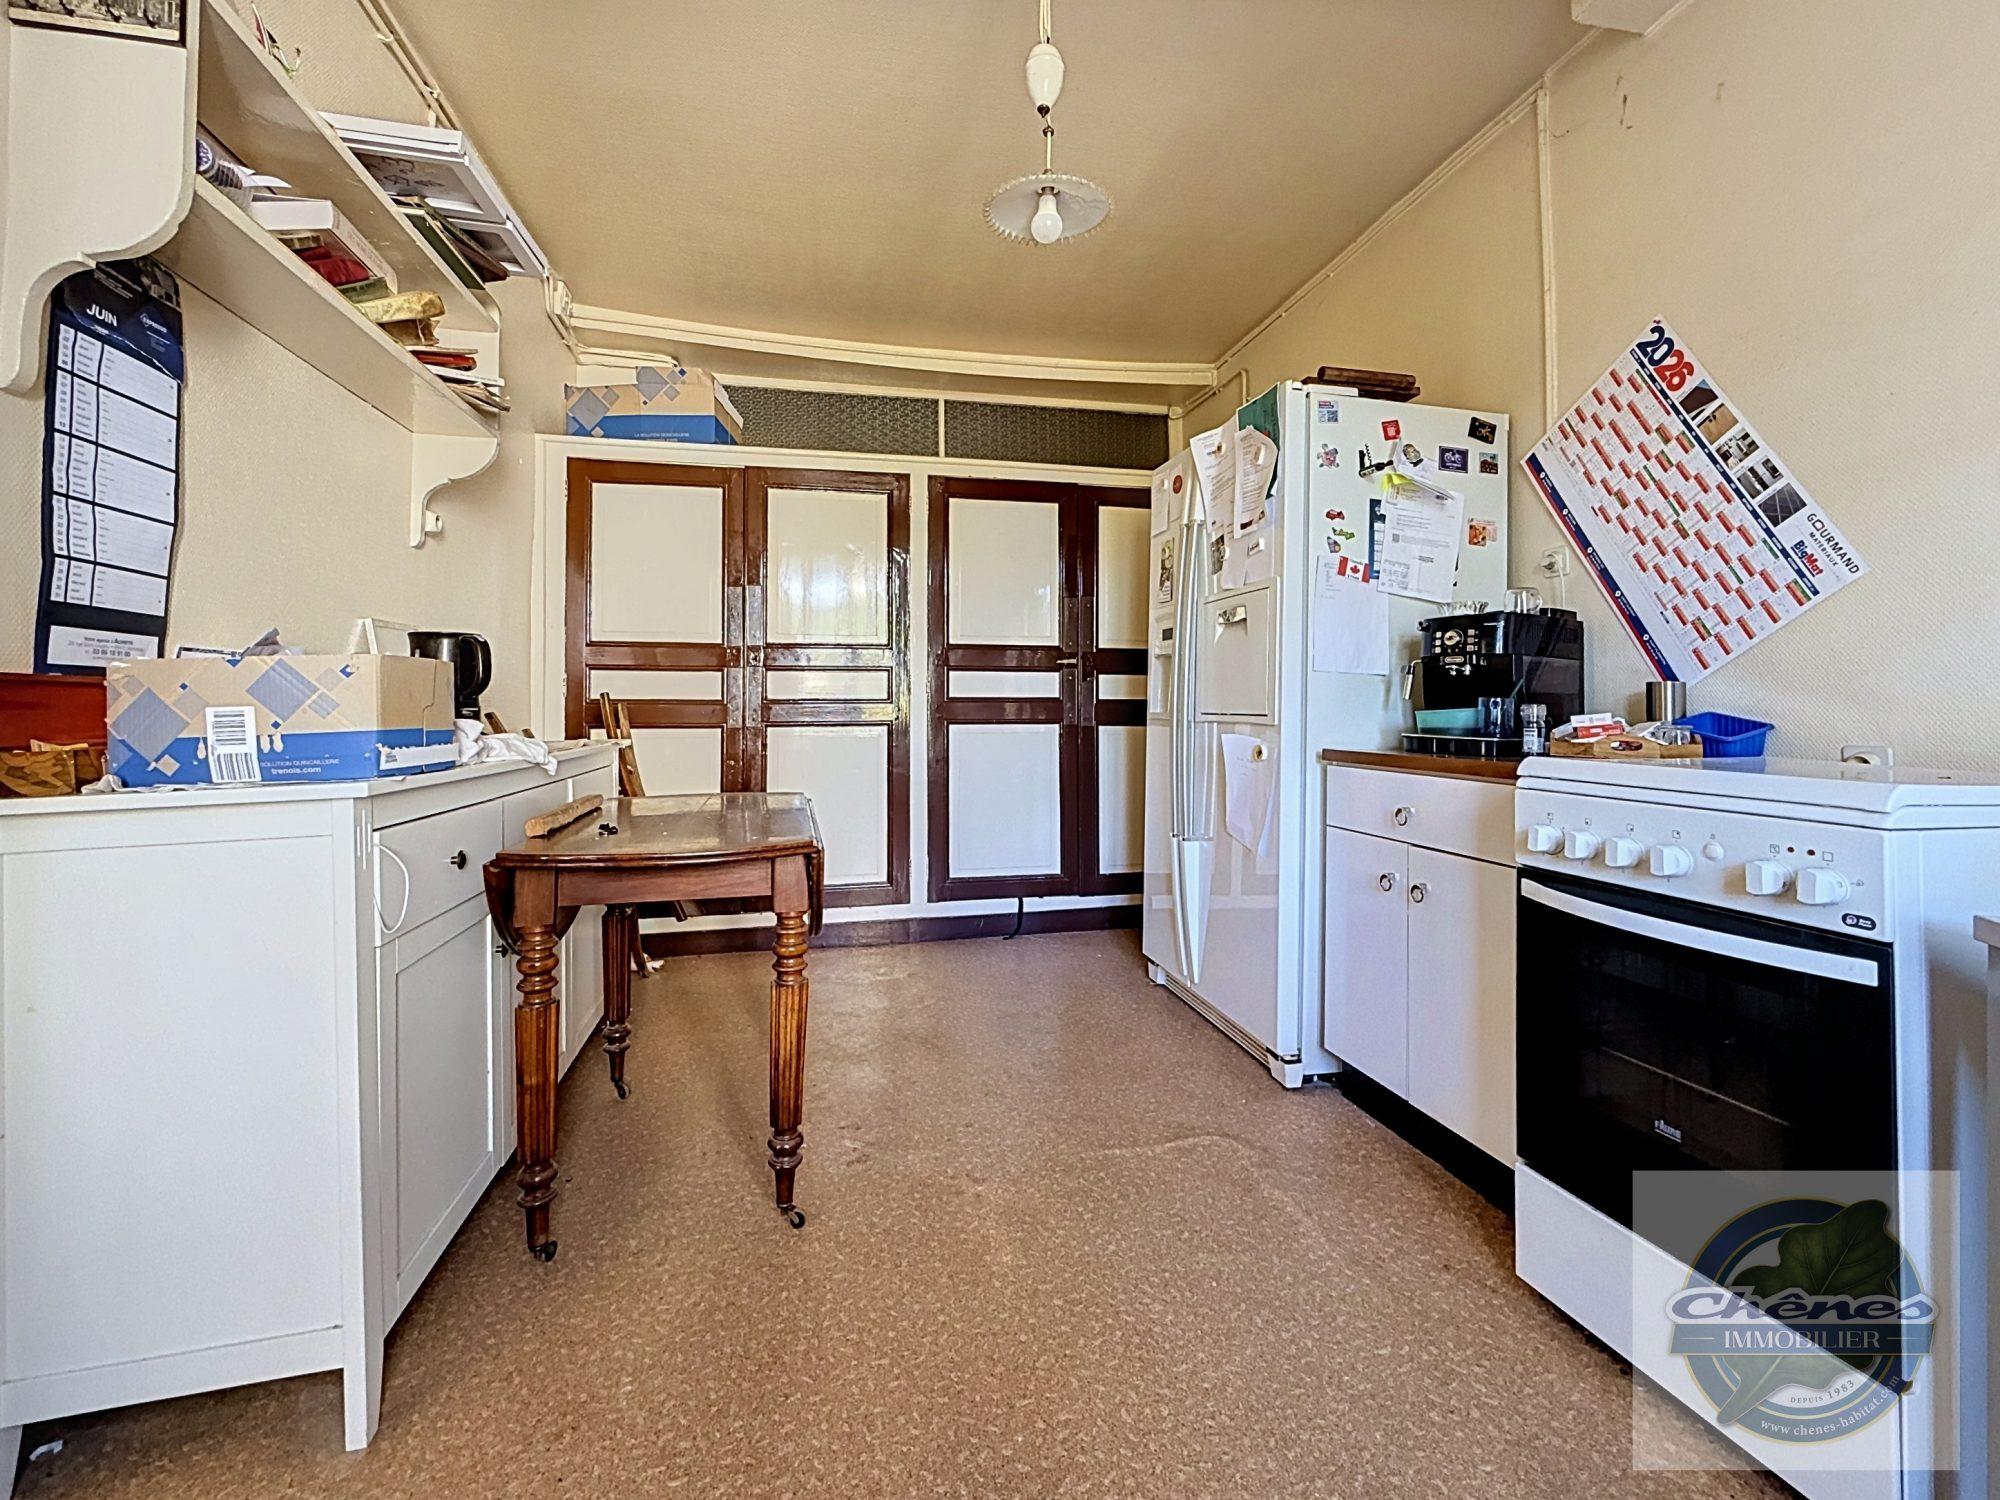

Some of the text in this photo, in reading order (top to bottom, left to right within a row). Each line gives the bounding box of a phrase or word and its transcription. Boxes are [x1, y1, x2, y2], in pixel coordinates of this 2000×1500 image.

[86, 304, 118, 327] JUIN
[1636, 325, 1695, 392] 2026
[1793, 540, 1824, 576] BigMat
[1807, 513, 1860, 574] GOURMAND
